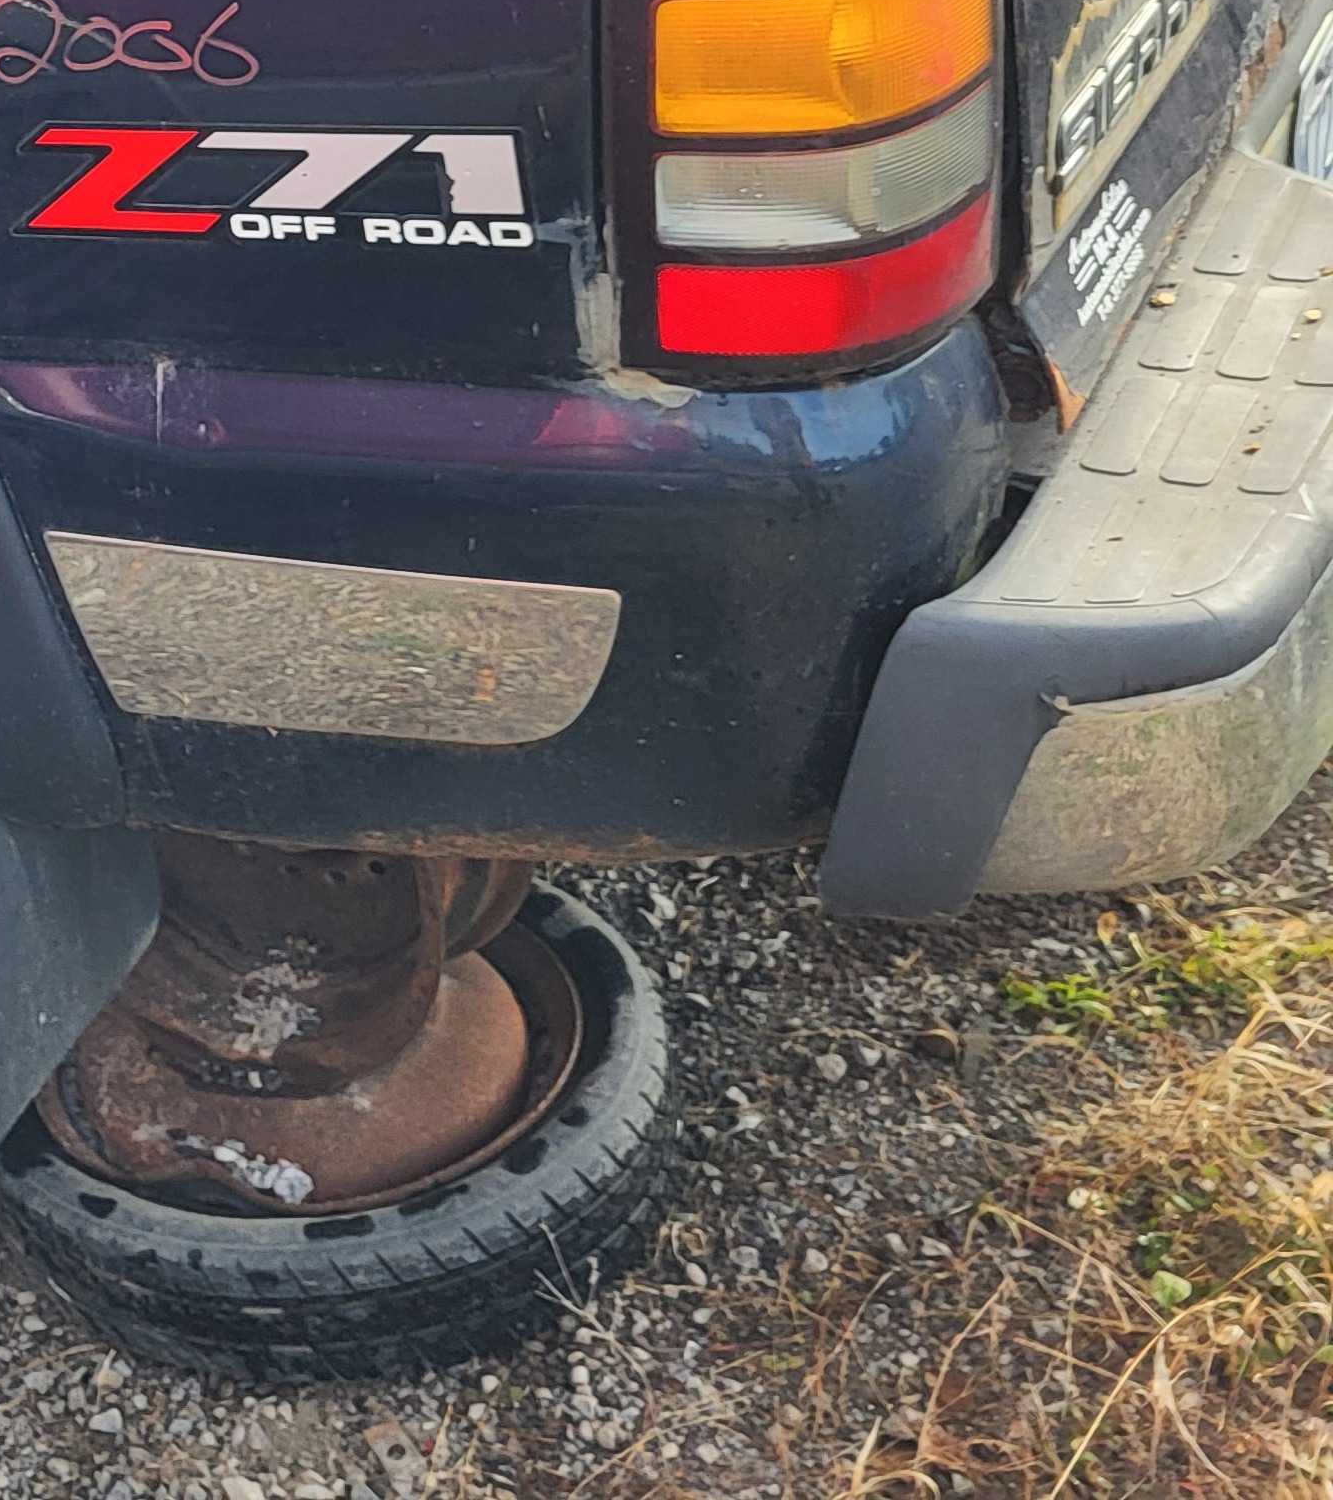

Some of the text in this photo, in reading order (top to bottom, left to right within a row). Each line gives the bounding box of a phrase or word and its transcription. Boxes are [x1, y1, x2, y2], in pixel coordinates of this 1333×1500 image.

[23, 128, 528, 235] Z71
[229, 213, 535, 248] OFF ROAD
